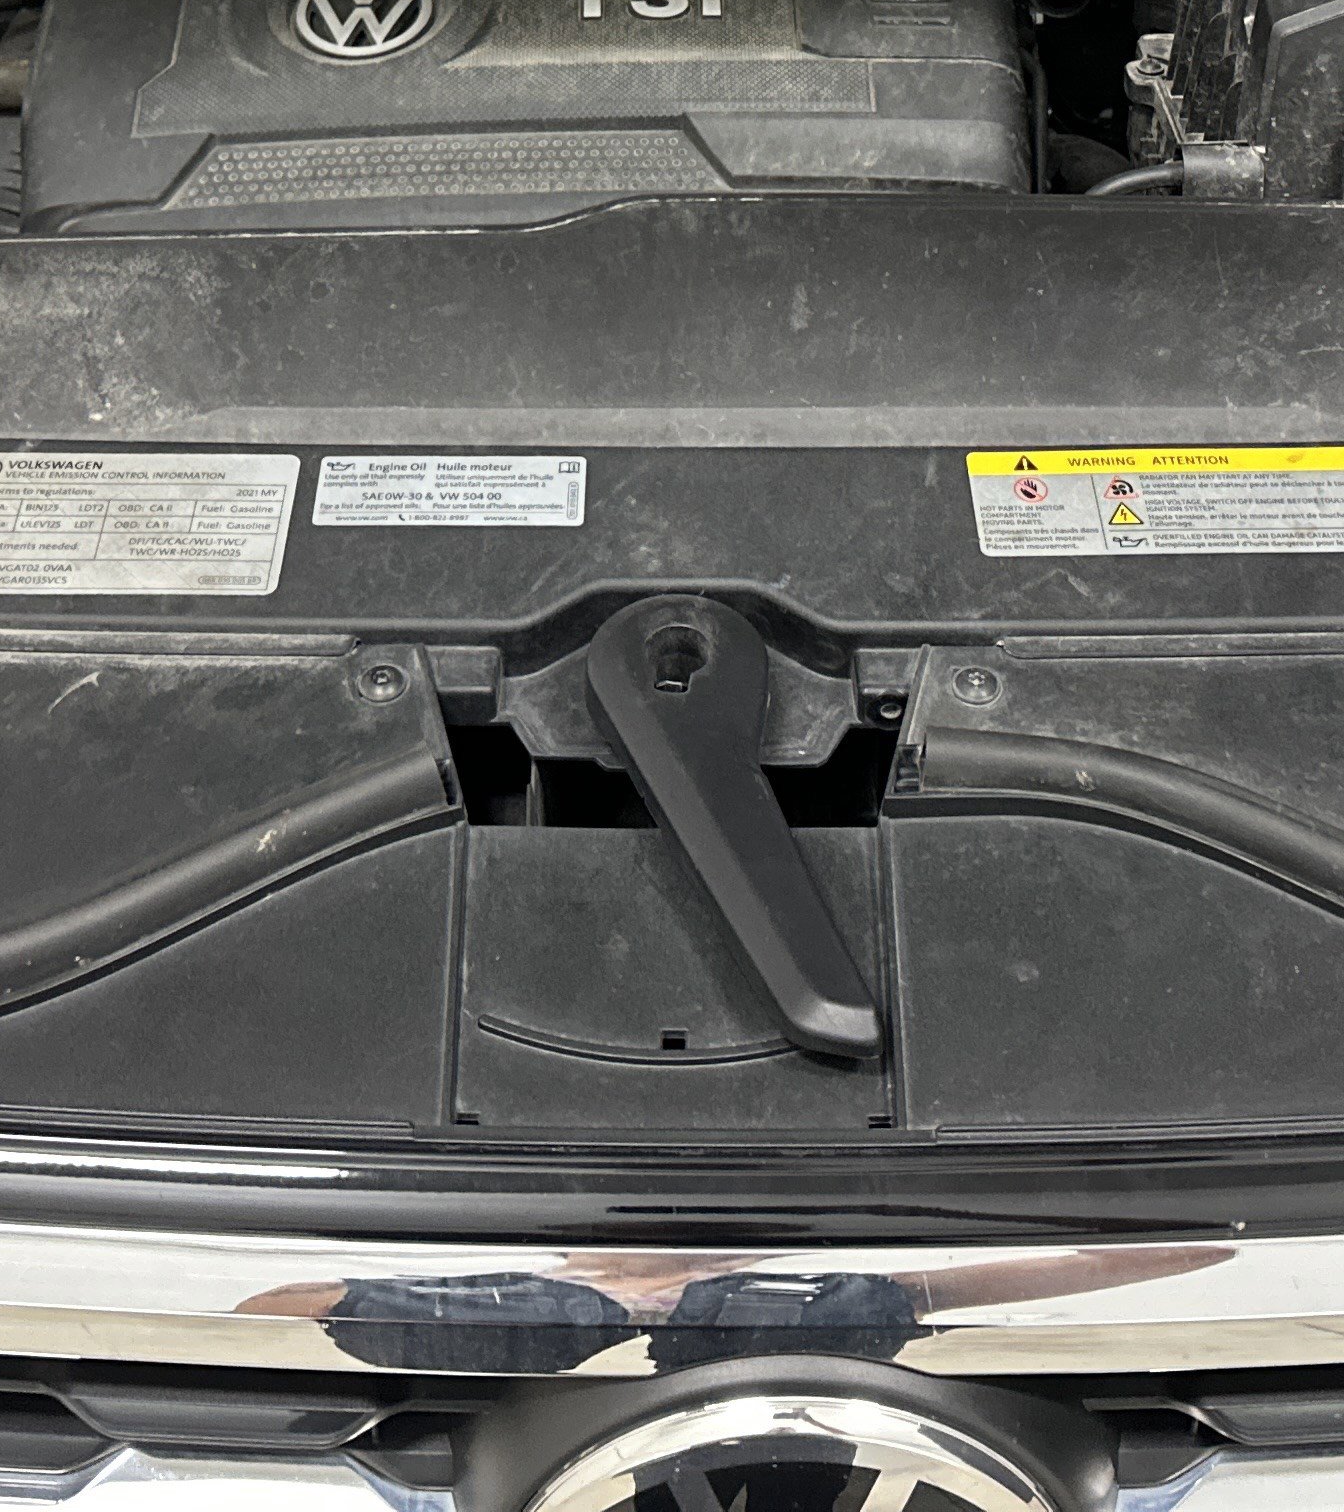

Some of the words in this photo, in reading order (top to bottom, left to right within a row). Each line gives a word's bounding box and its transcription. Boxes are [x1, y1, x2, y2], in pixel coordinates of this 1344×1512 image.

[9, 461, 103, 469] VOLKSWAGEN
[1067, 458, 1136, 466] WARNING
[1152, 456, 1229, 465] ATTENTION
[368, 463, 408, 473] Engine
[410, 463, 427, 471] Oil
[437, 463, 467, 471] Huile
[470, 463, 512, 471] moteur
[101, 472, 149, 480] CONTROL
[152, 472, 226, 480] INFORMATION
[36, 488, 95, 498] regulations:
[236, 489, 258, 497] 2021
[260, 489, 278, 497] MY
[440, 492, 459, 500] VW
[463, 492, 484, 500] 504
[487, 492, 502, 500] 00
[117, 504, 143, 512] OBD:
[201, 505, 225, 513] Fuel:
[230, 505, 274, 513] Gasoline
[114, 521, 139, 529] OBD:
[226, 522, 271, 530] Gasoline
[39, 542, 79, 550] needed.
